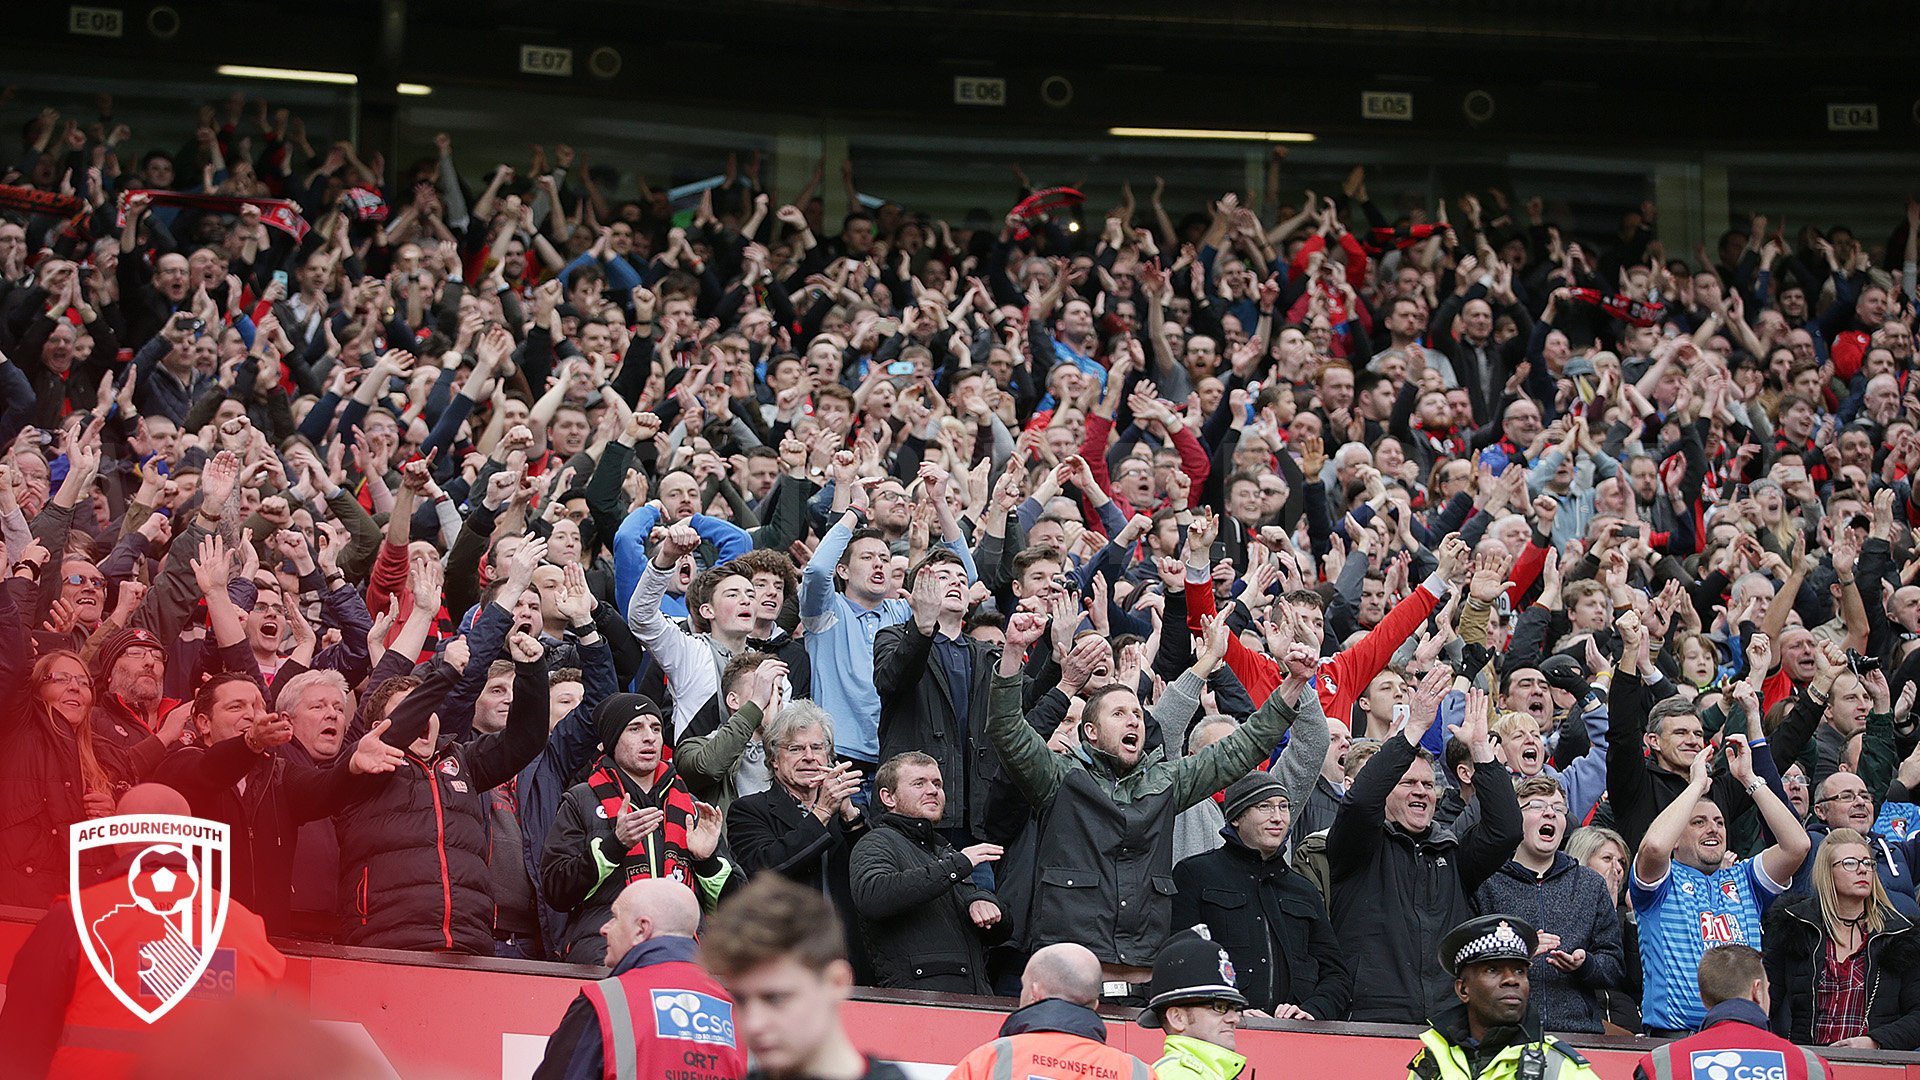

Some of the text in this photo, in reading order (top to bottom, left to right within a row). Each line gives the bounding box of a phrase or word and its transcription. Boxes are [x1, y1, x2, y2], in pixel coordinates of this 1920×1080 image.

[76, 12, 117, 33] E08
[528, 50, 567, 71] E07
[960, 82, 1001, 101] E06
[1368, 97, 1408, 115] E05
[1833, 109, 1872, 126] E04
[692, 1012, 734, 1038] CSG
[683, 1051, 719, 1071] QRT
[1032, 1054, 1118, 1080] RESPONSE TEAM
[1734, 1065, 1784, 1080] CSG
